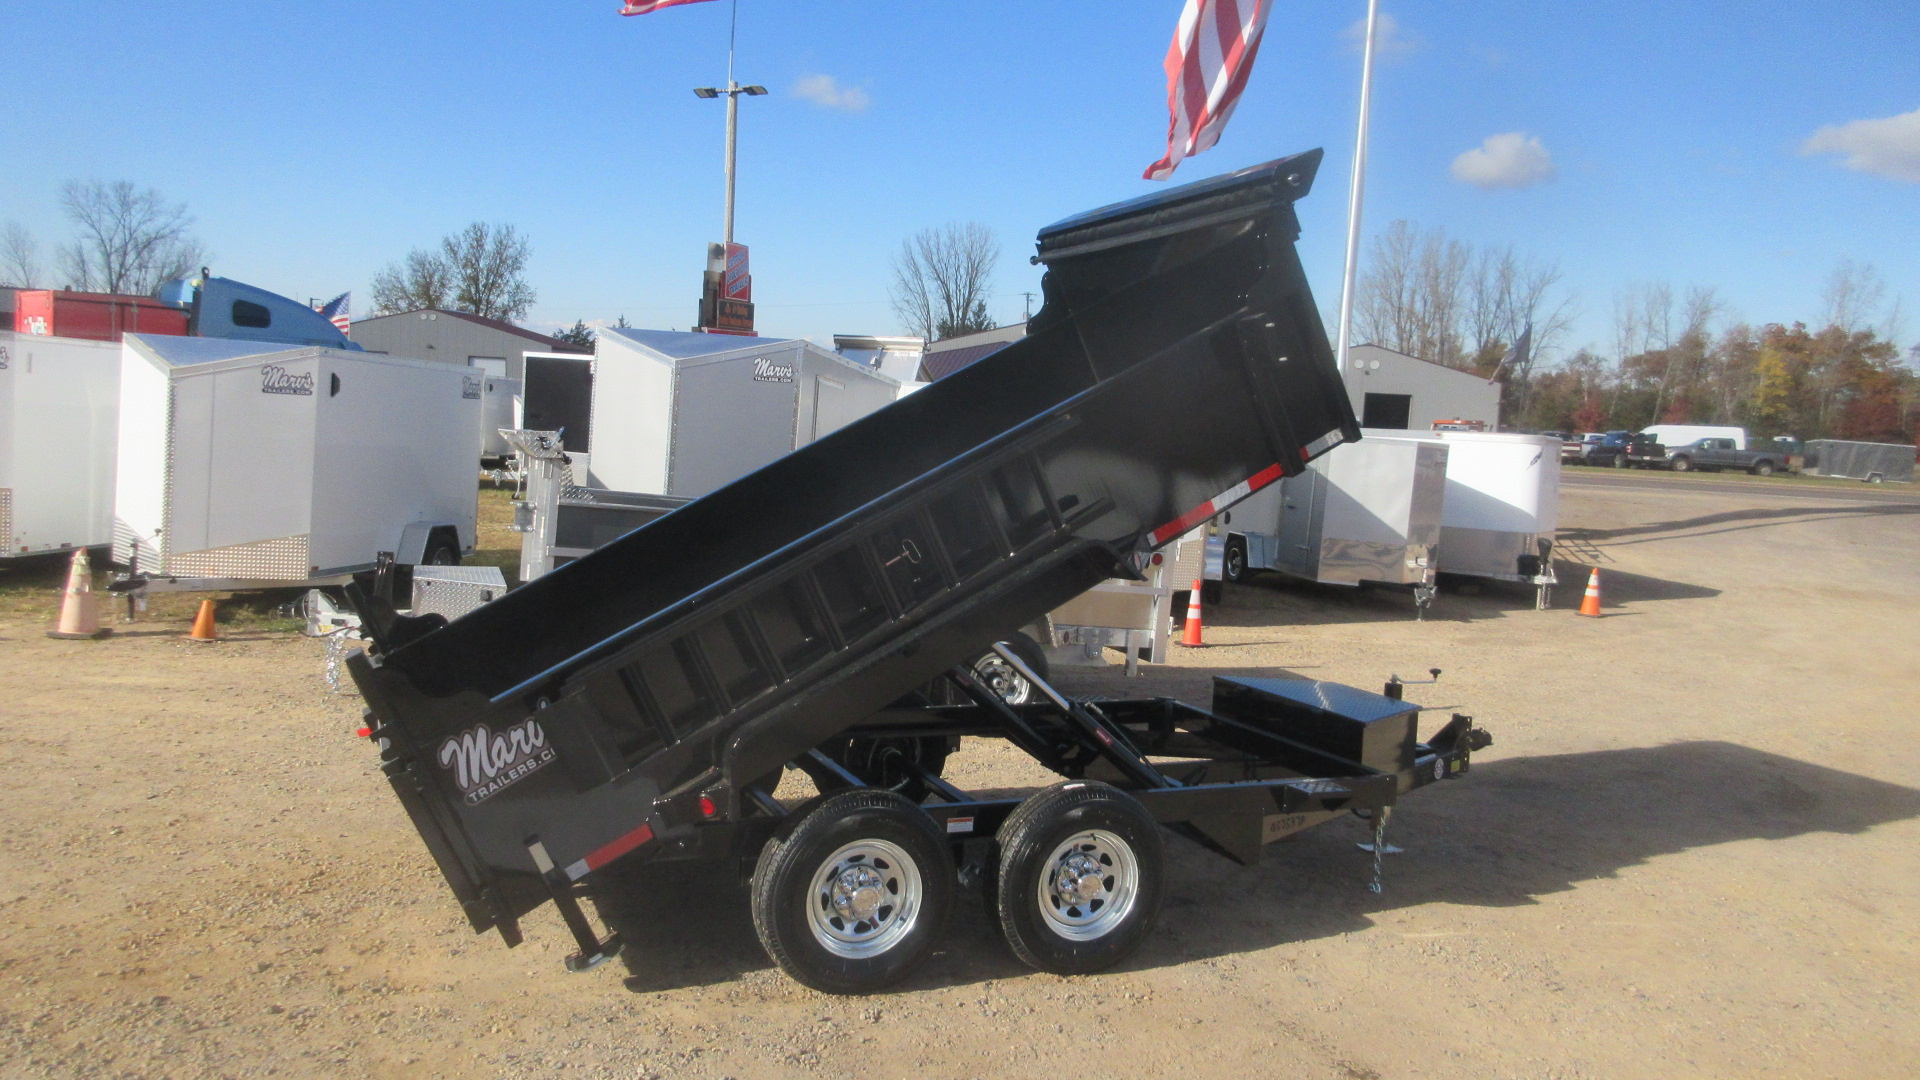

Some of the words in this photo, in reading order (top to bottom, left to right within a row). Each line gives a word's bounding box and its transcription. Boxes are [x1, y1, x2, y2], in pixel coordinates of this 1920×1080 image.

[261, 365, 314, 389] Marv's
[753, 357, 794, 377] Marv's
[468, 746, 556, 802] TRAILERS.C
